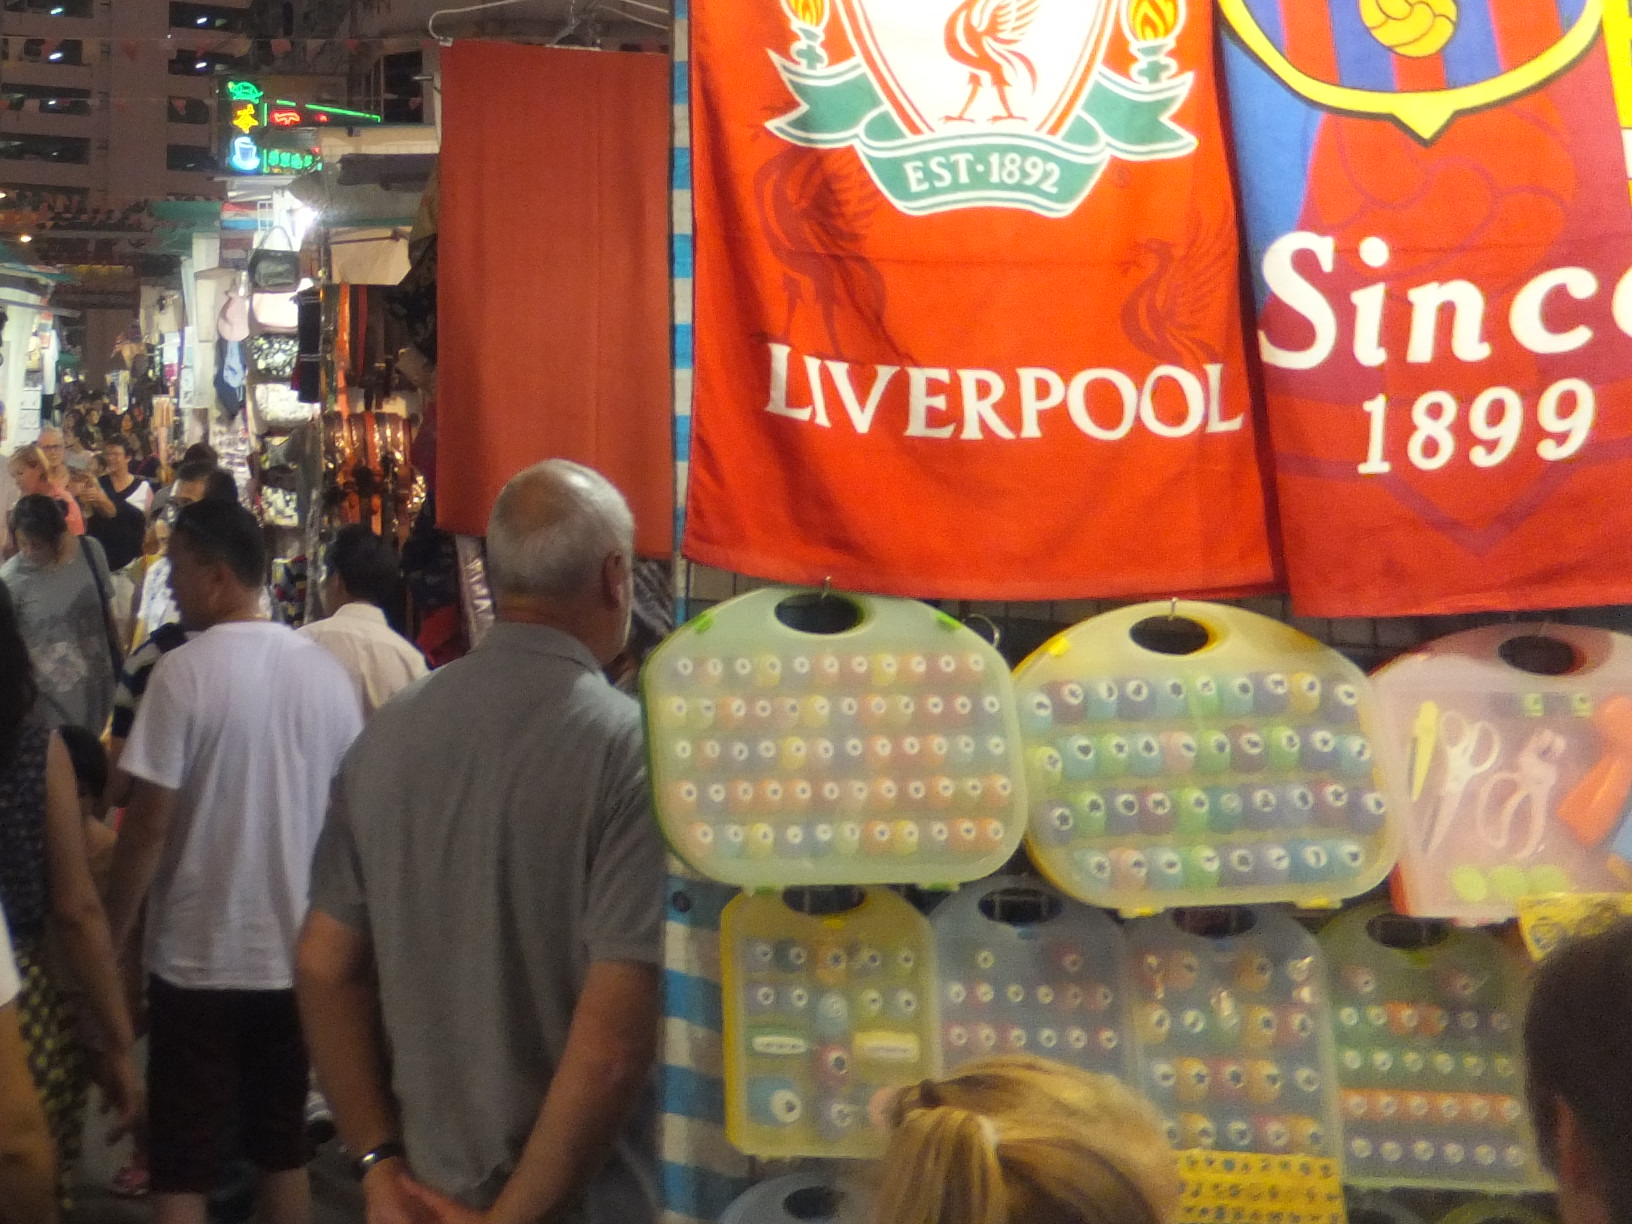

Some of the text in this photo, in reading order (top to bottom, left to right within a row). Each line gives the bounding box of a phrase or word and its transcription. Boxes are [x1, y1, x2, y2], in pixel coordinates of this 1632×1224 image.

[1257, 231, 1632, 370] Sinc
[763, 344, 1244, 441] LIVERPOOL
[1357, 378, 1596, 475] 1899
